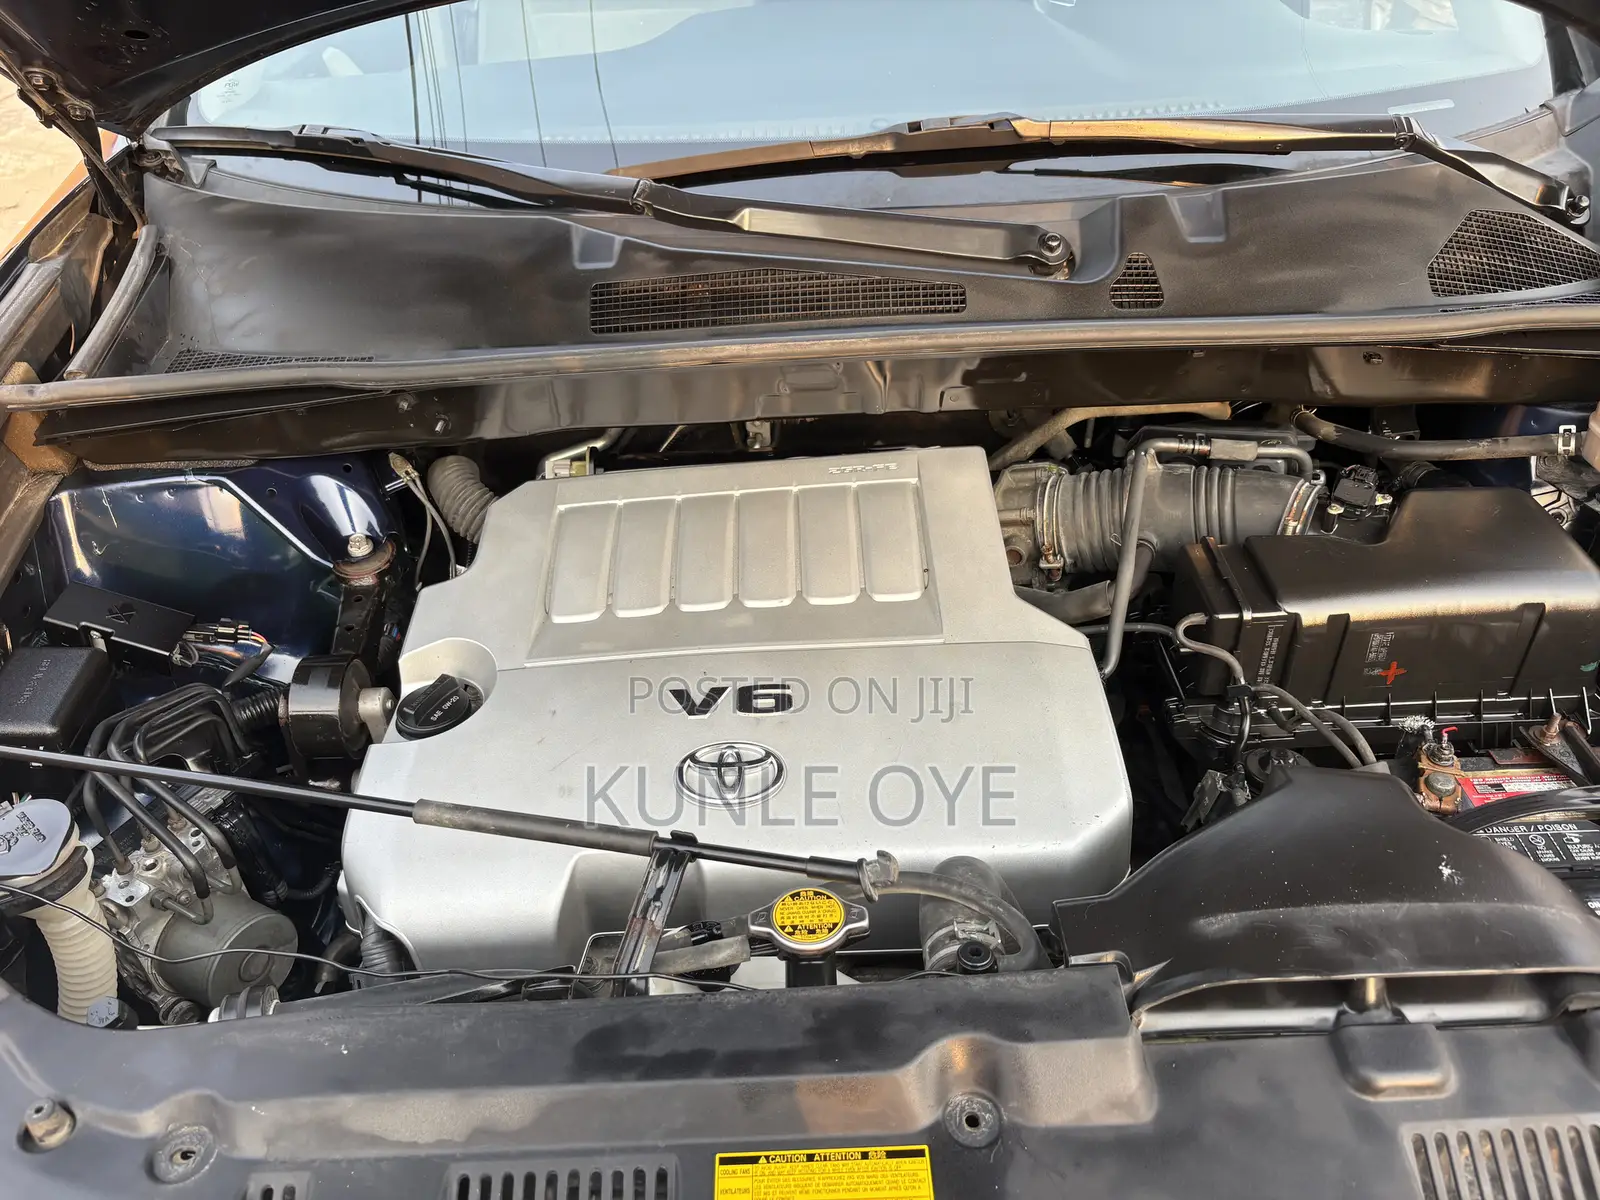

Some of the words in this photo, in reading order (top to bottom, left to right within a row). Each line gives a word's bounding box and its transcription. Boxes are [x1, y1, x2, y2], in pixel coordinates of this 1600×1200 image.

[668, 683, 794, 720] V6
[1537, 823, 1578, 832] POISON
[797, 923, 833, 931] ATTENTION
[769, 1154, 807, 1163] CAUTION
[814, 1152, 862, 1162] ATTENTION
